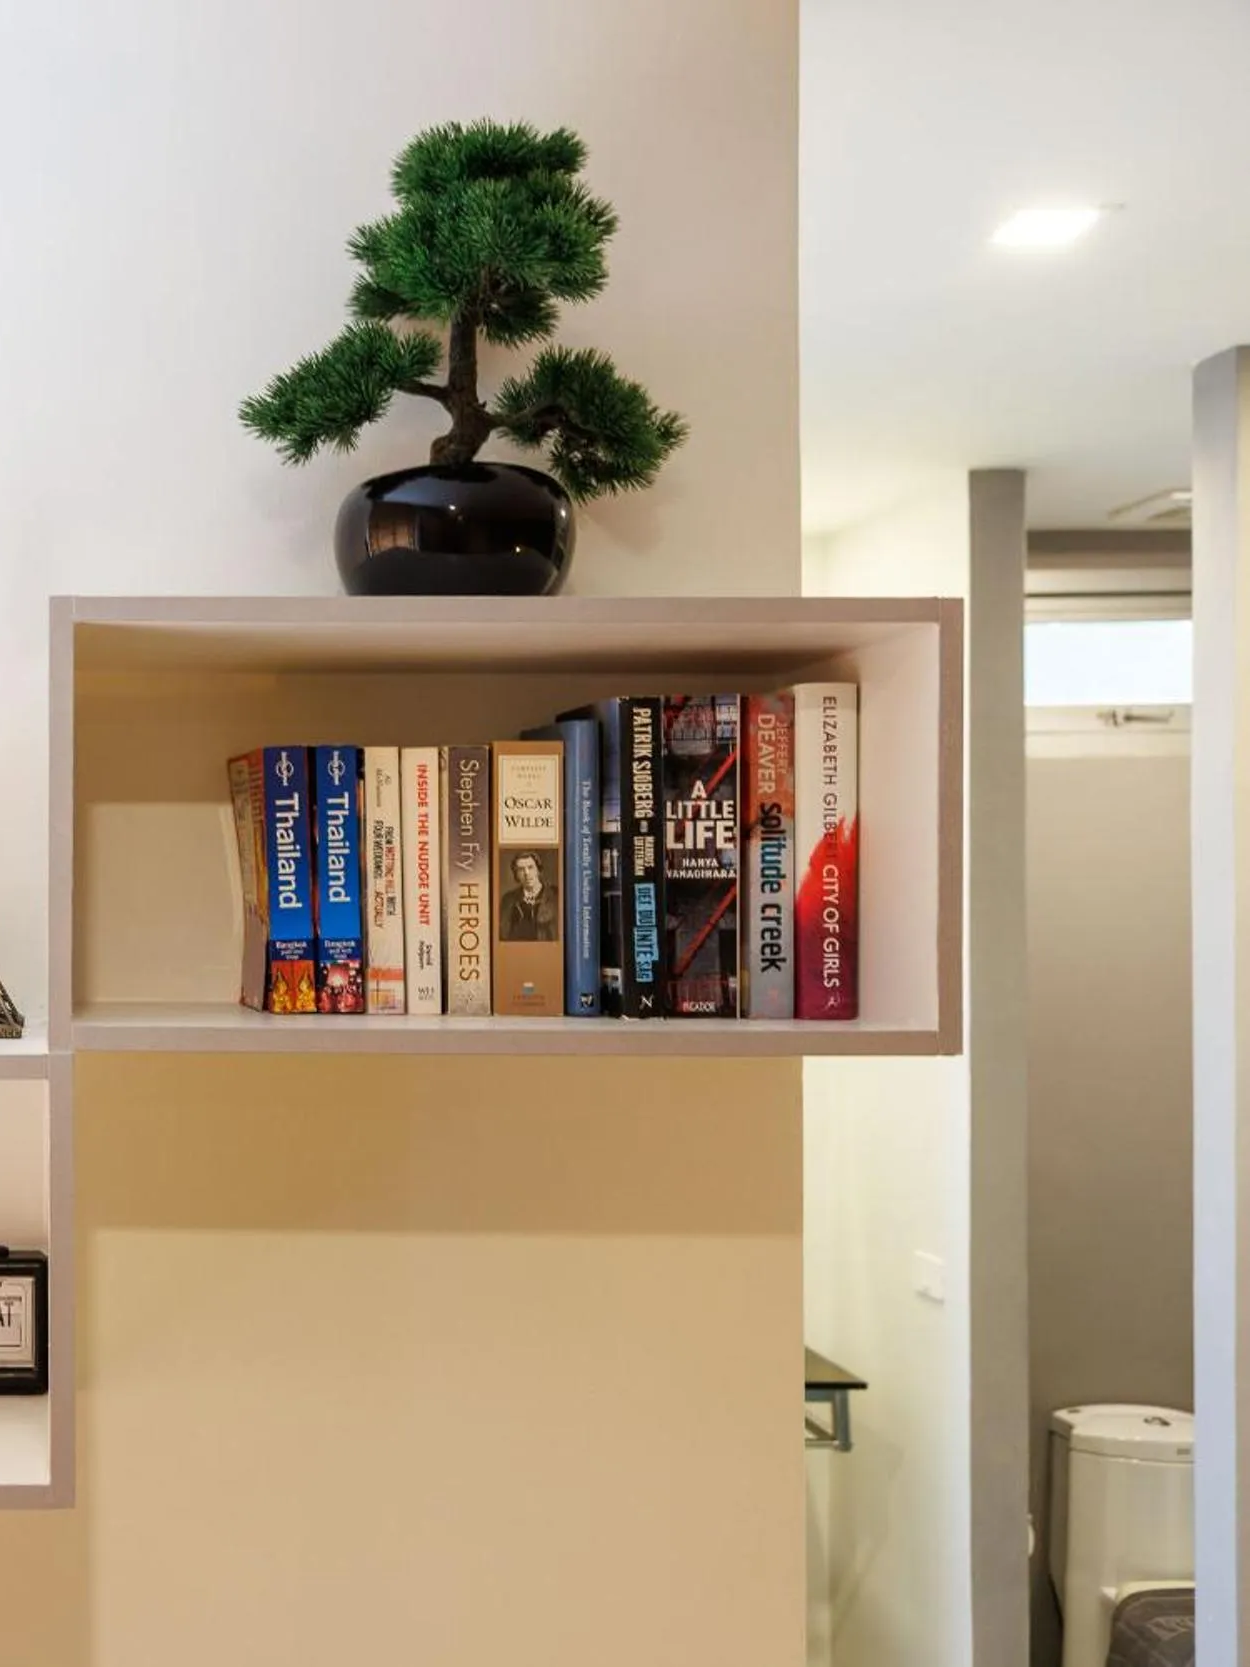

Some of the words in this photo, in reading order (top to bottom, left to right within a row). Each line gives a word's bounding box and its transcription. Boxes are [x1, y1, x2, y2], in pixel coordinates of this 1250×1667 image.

[633, 707, 652, 759] PATRIK
[758, 714, 776, 794] DEAVER
[823, 695, 838, 785] ELIZABETH
[417, 764, 428, 807] INSIDE
[458, 759, 479, 837] Stephen
[505, 797, 553, 809] OSCAR
[691, 780, 707, 799] A
[418, 813, 429, 836] THE
[505, 815, 554, 828] WILDE
[666, 801, 735, 819] LITTLE
[823, 793, 838, 860] GILBERT
[275, 791, 302, 909] Thailand
[326, 791, 350, 902] Thailand
[456, 842, 480, 872] Fry
[666, 820, 735, 849] LIFE
[760, 802, 787, 894] solitude
[418, 841, 430, 889] NUDGE
[682, 858, 719, 867] HANYA
[823, 864, 838, 905] CITY
[419, 894, 430, 926] UNIT
[459, 882, 480, 981] HEROES
[823, 908, 839, 933] OF
[761, 902, 787, 972] creek
[824, 940, 839, 988] GIRLS
